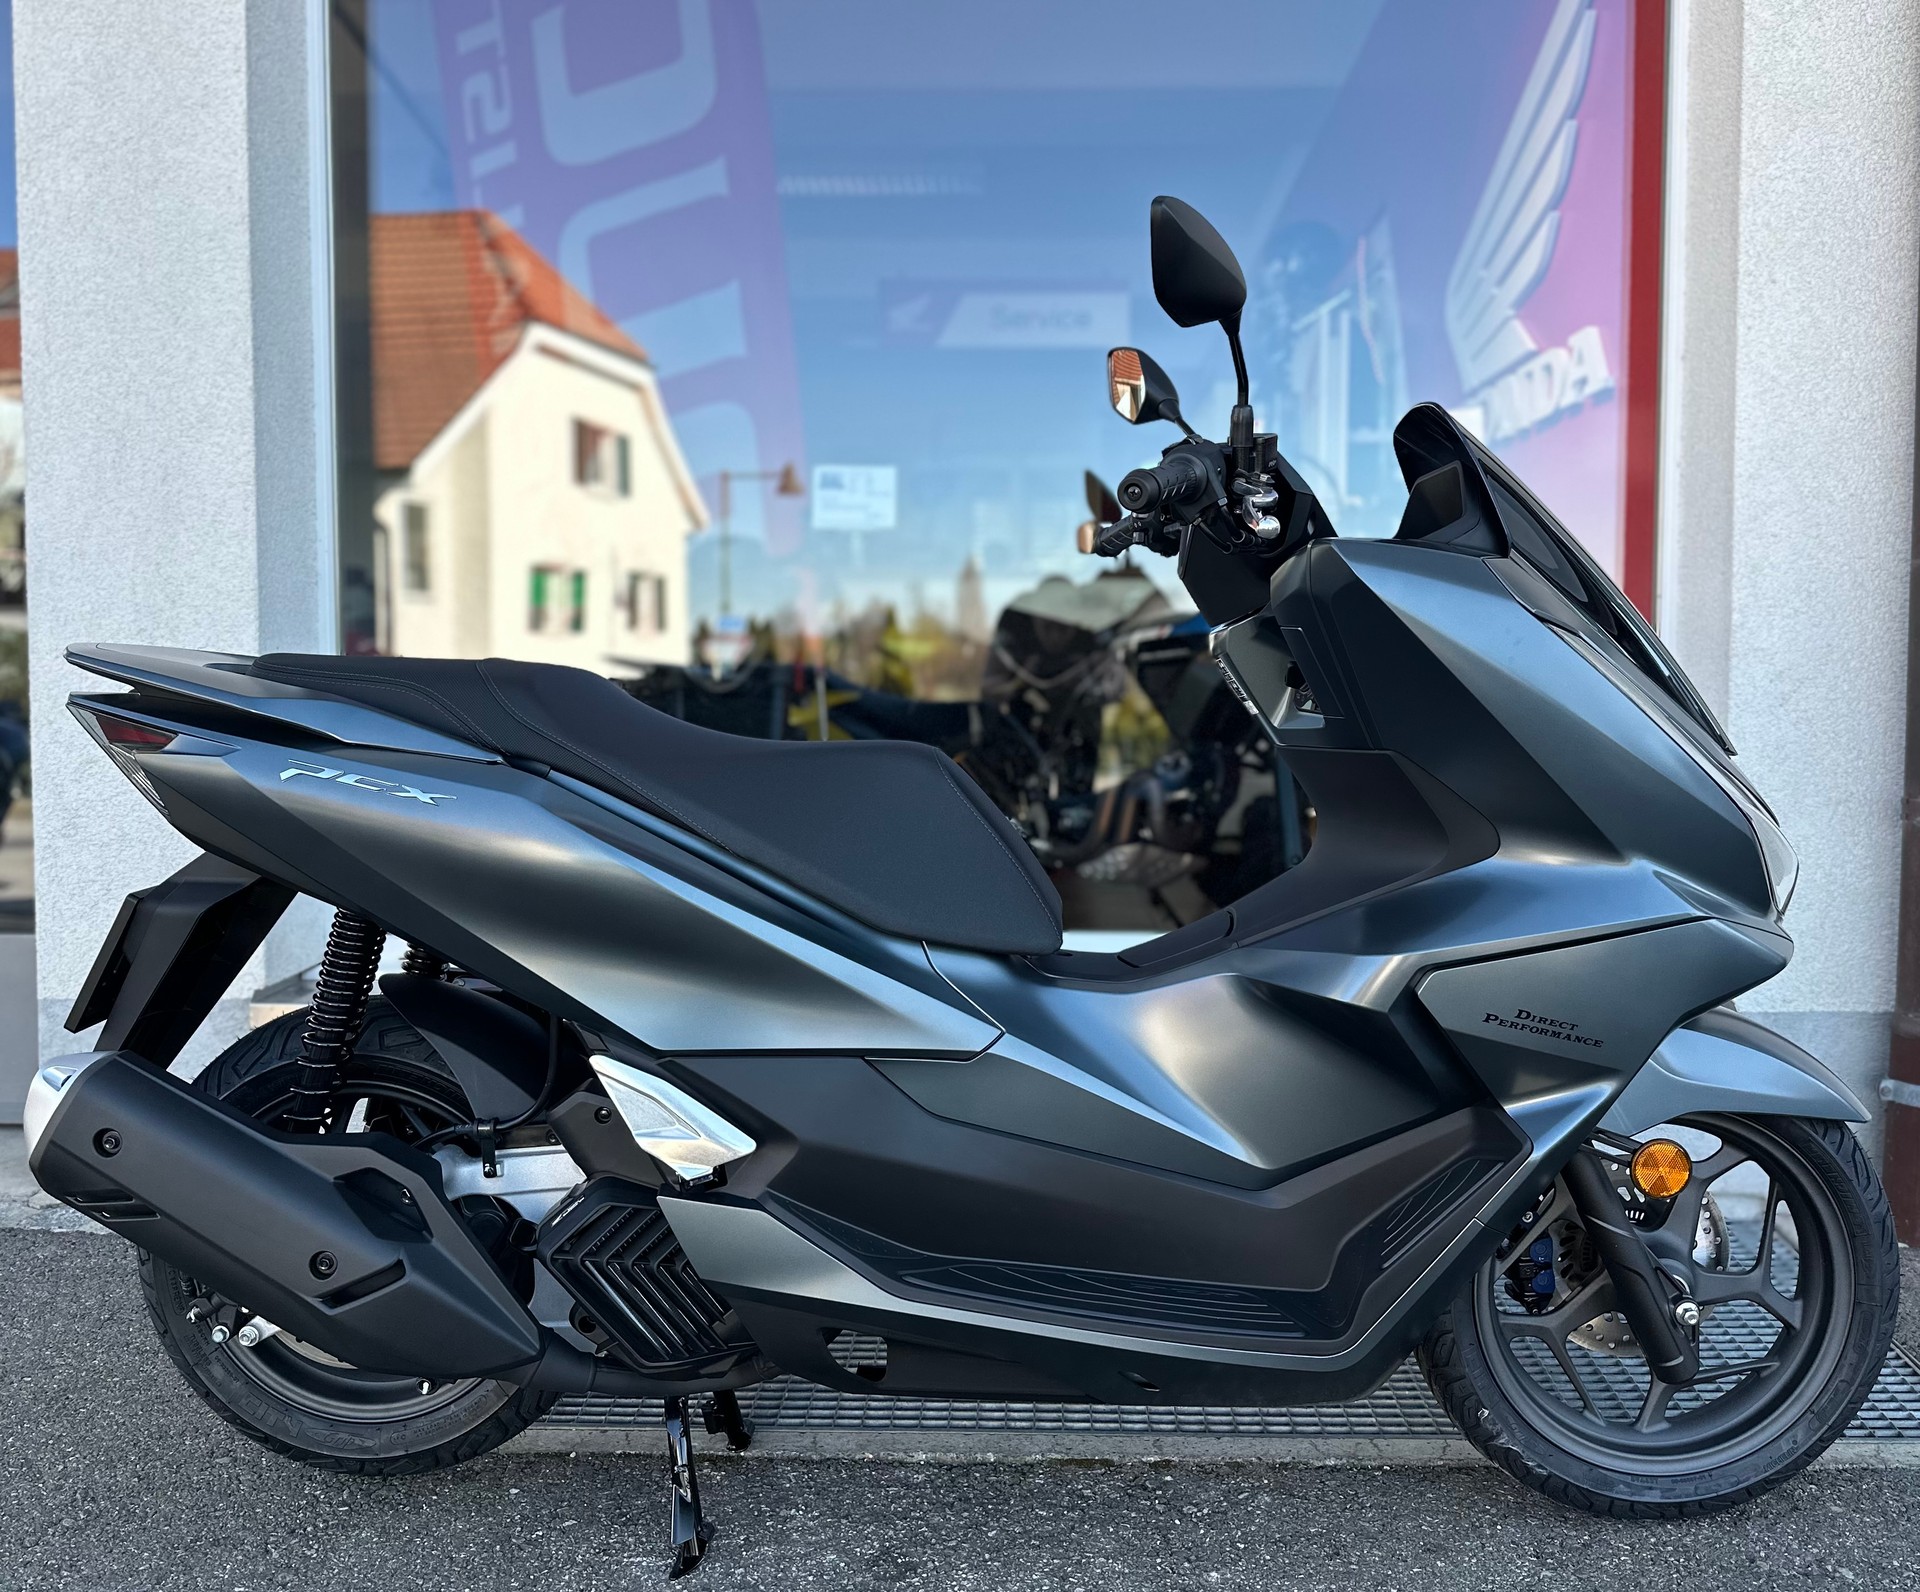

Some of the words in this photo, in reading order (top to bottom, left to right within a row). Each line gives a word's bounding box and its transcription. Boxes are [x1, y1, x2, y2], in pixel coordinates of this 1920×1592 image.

[991, 304, 1092, 330] Service
[279, 759, 457, 806] PCX
[1482, 1012, 1604, 1048] PERFORMANCE
[1515, 1008, 1579, 1031] DIRECT
[239, 1391, 303, 1438] CITY
